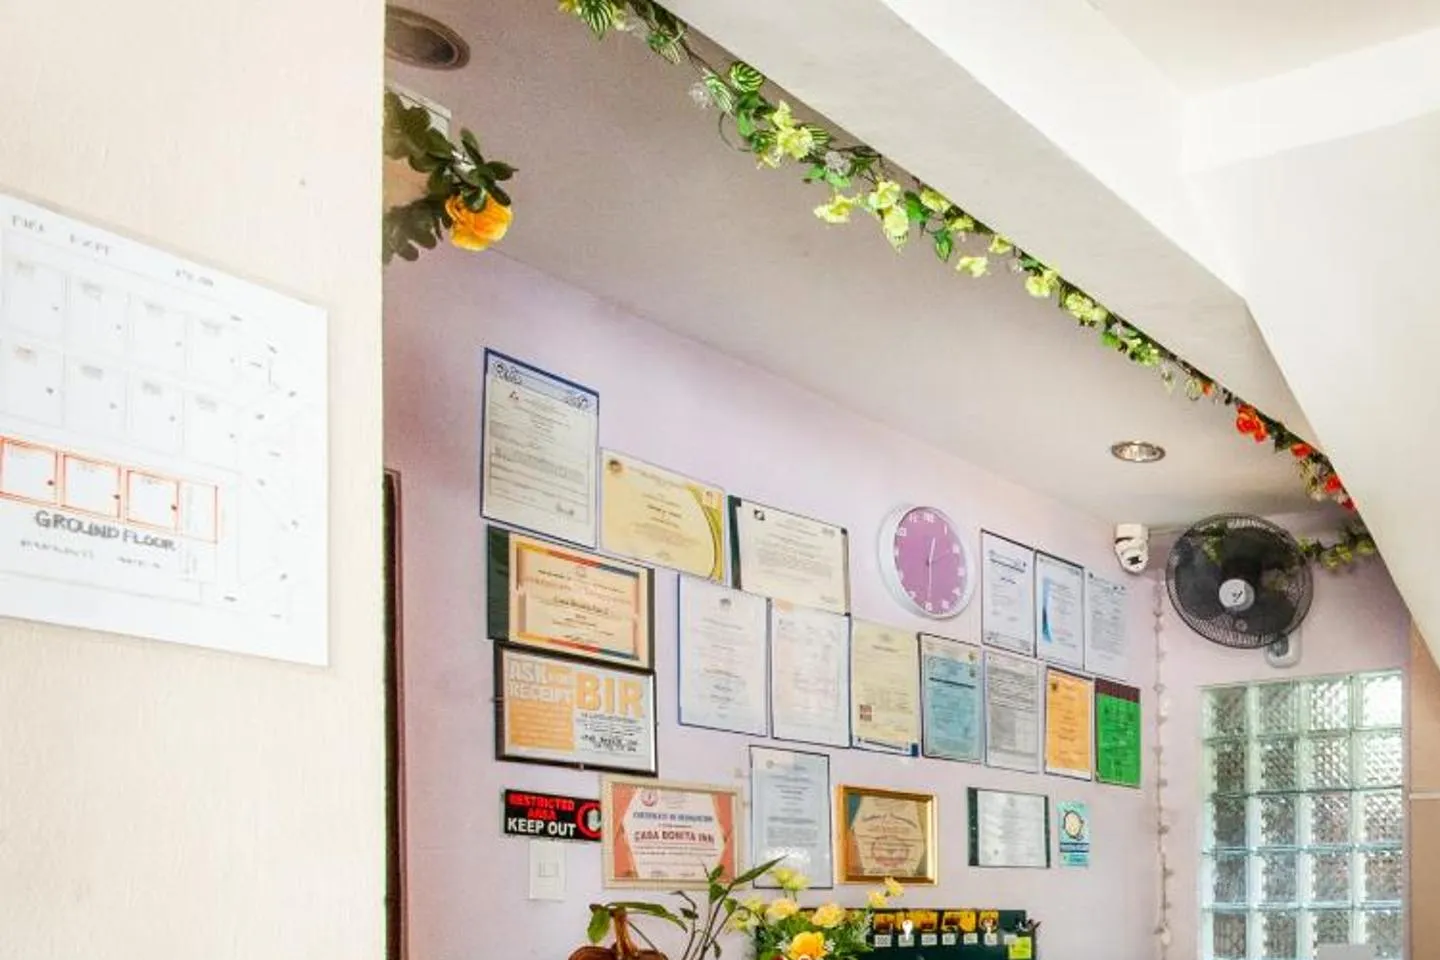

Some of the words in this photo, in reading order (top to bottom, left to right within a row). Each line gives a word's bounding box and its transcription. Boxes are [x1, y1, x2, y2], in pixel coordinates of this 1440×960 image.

[34, 510, 119, 539] GROUND
[122, 528, 177, 551] FLOOR
[576, 672, 645, 719] BIR
[509, 792, 575, 812] RESTRICTED
[507, 817, 544, 834] KEEP
[547, 821, 577, 837] OUT
[634, 830, 660, 843] CASA
[661, 830, 697, 842] BONITA
